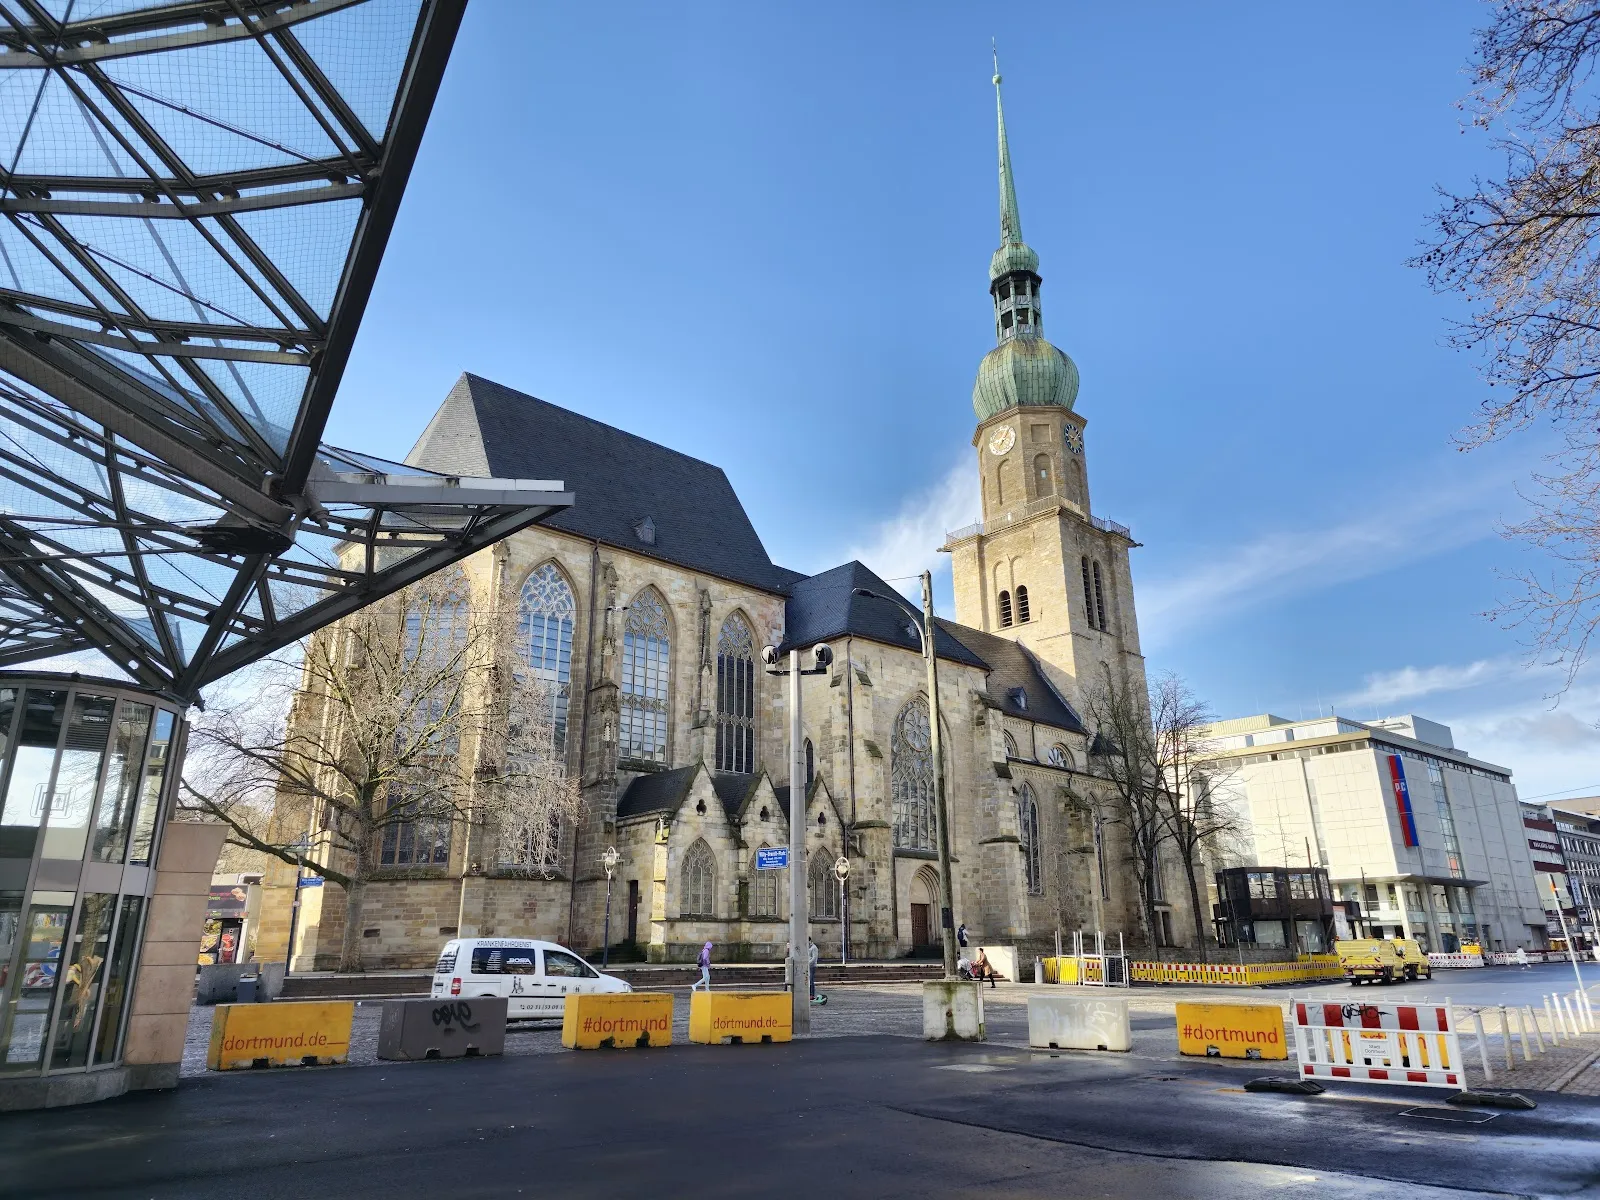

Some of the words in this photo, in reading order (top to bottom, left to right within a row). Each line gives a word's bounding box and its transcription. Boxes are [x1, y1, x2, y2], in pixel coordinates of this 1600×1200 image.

[476, 940, 532, 948] KRANKENFAHRDIENST
[583, 1014, 668, 1033] #dortmund
[1183, 1023, 1279, 1044] #dortmund
